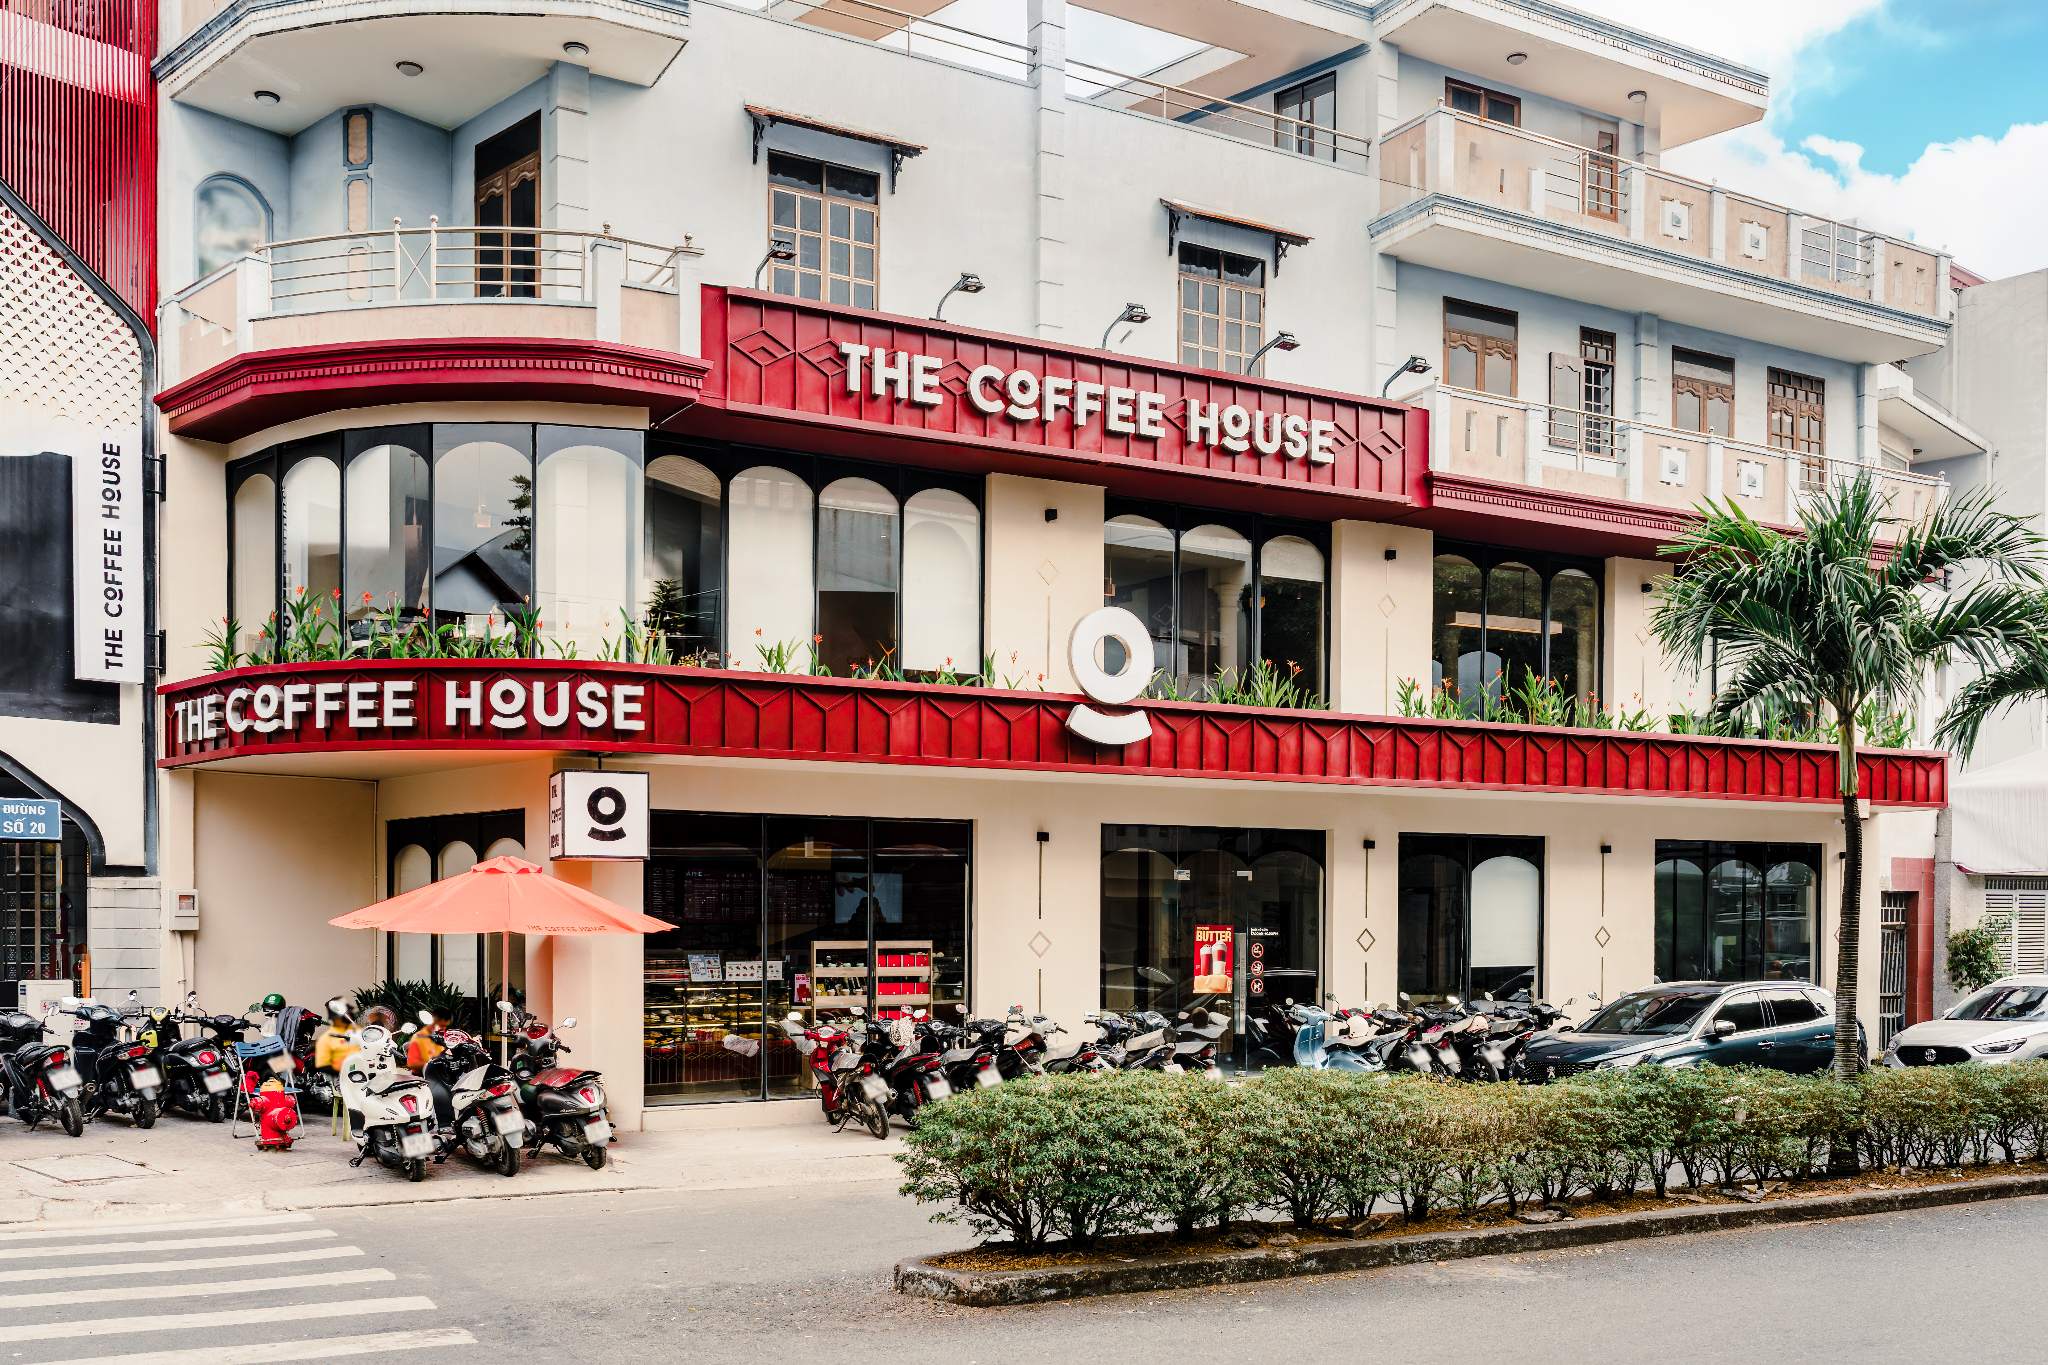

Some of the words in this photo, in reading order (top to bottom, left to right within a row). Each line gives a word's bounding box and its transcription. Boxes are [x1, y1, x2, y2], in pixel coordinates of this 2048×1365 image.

[838, 341, 944, 407] THE
[967, 363, 1167, 439] COFFEE
[1186, 397, 1337, 465] HOUSE
[101, 442, 121, 519] HOUSE
[103, 528, 123, 618] COFFEE
[104, 628, 124, 670] THE
[174, 693, 226, 744] THE
[225, 680, 417, 734] COFFEE
[445, 678, 647, 732] HOUSE
[3, 802, 46, 816] ĐƯỜNG
[3, 817, 27, 834] SỐ
[30, 821, 46, 835] 20
[1195, 930, 1232, 942] BUTTER
